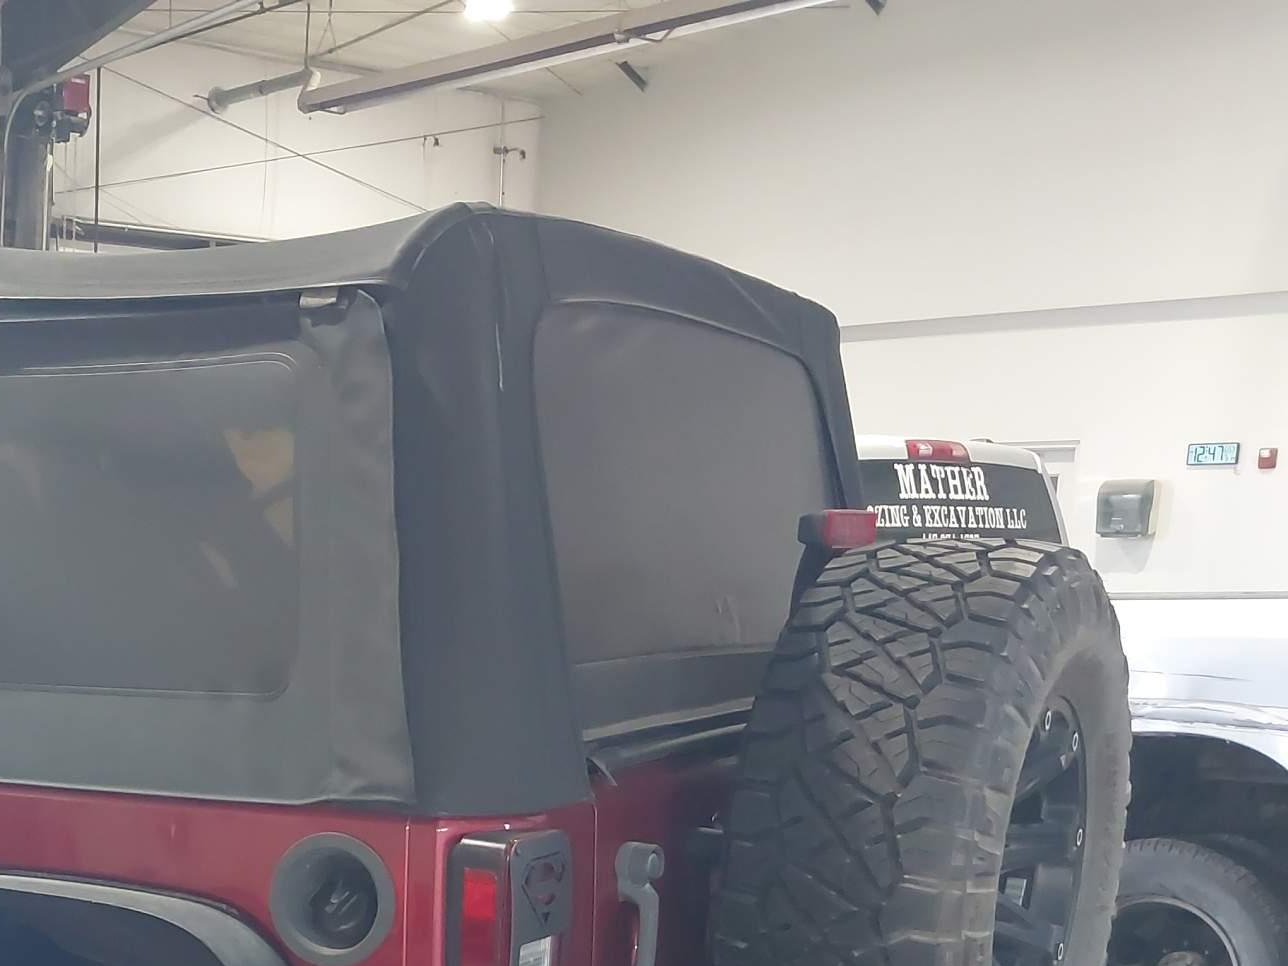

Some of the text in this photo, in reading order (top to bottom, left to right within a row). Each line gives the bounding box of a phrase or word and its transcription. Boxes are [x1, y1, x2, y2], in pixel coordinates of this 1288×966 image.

[1193, 445, 1224, 463] 12:47
[894, 463, 989, 501] MATHER
[867, 504, 1027, 529] ZING & EXCAVATION LLC
